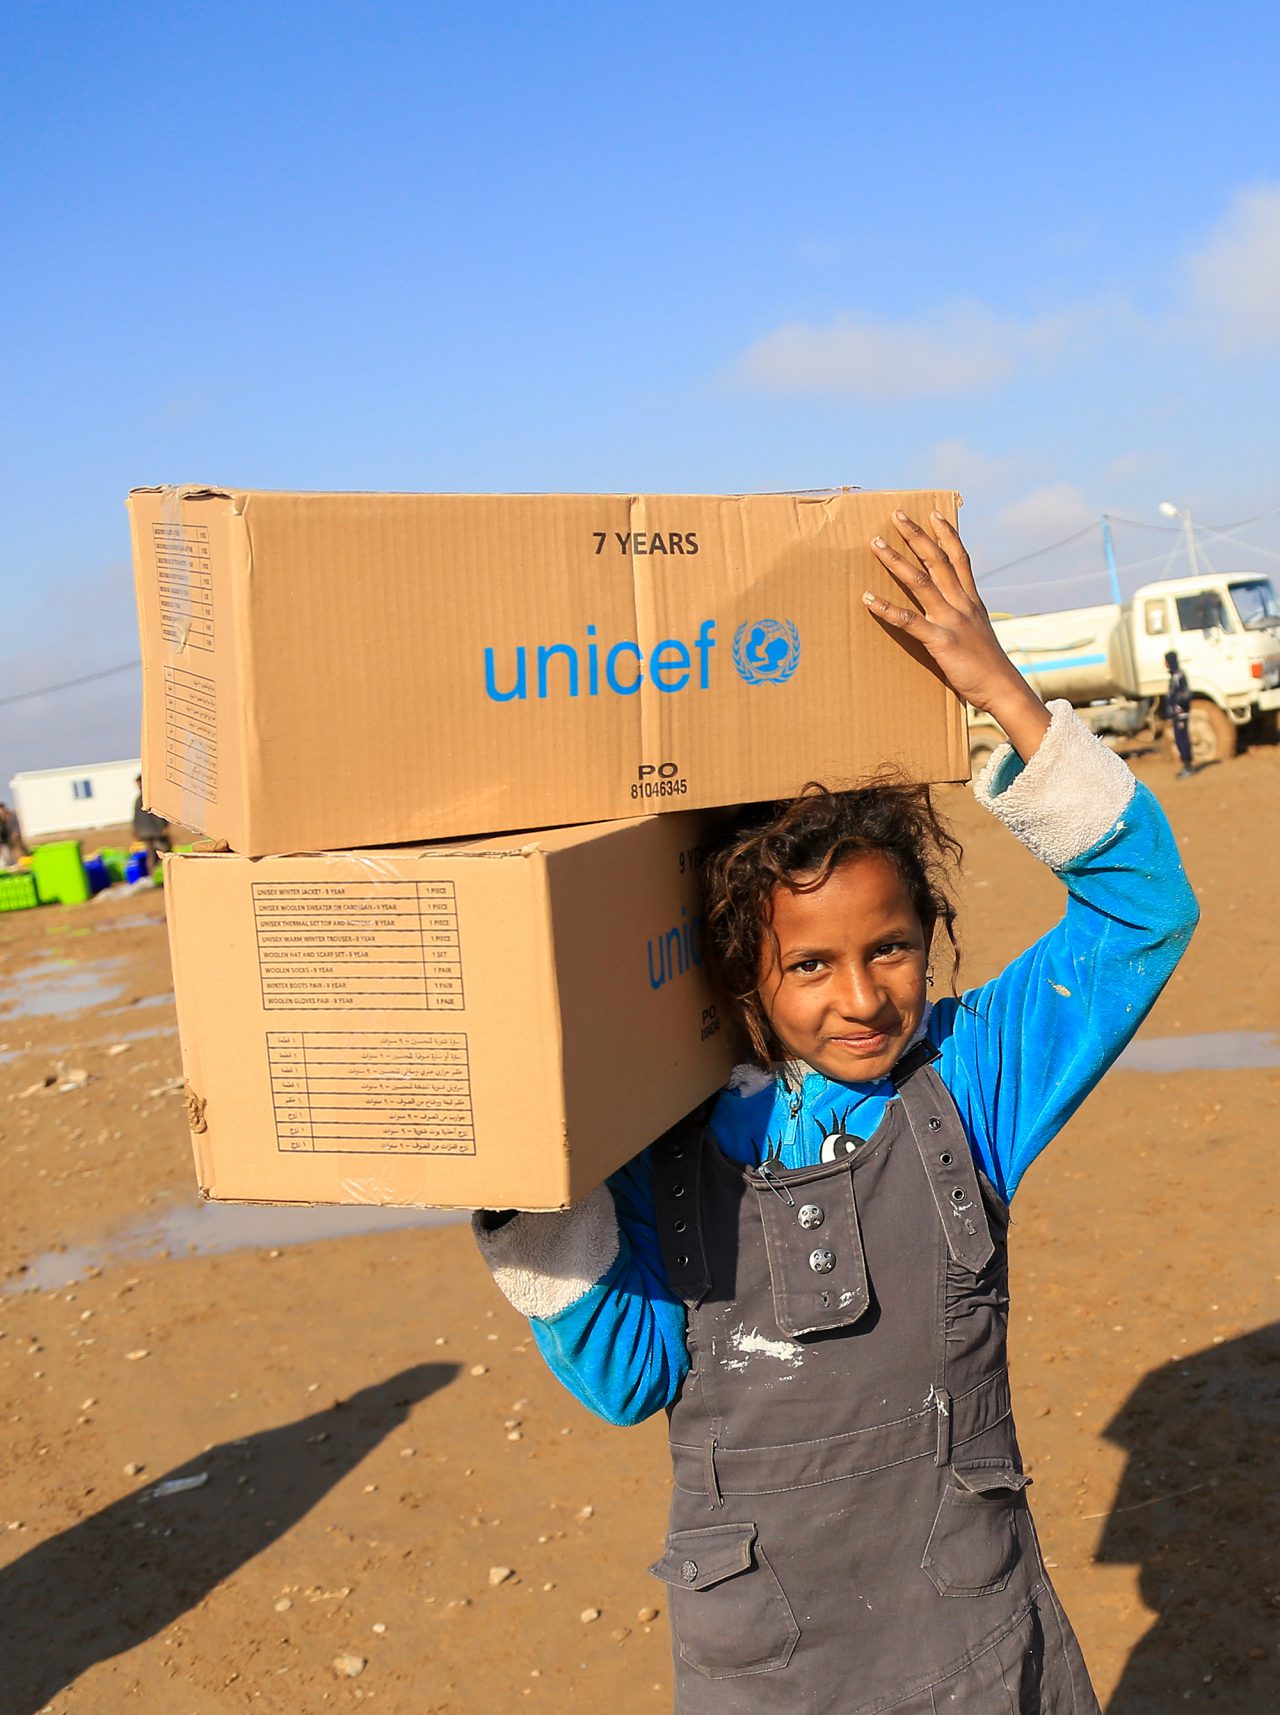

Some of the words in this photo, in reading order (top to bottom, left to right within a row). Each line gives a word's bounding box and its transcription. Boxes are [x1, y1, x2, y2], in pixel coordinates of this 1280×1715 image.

[593, 532, 606, 555] 7
[615, 532, 699, 555] YEARS
[484, 619, 716, 702] unicef
[638, 762, 678, 780] PO
[631, 779, 687, 800] 81046345
[679, 851, 685, 874] 9
[647, 906, 706, 990] unic
[702, 1004, 717, 1025] PO
